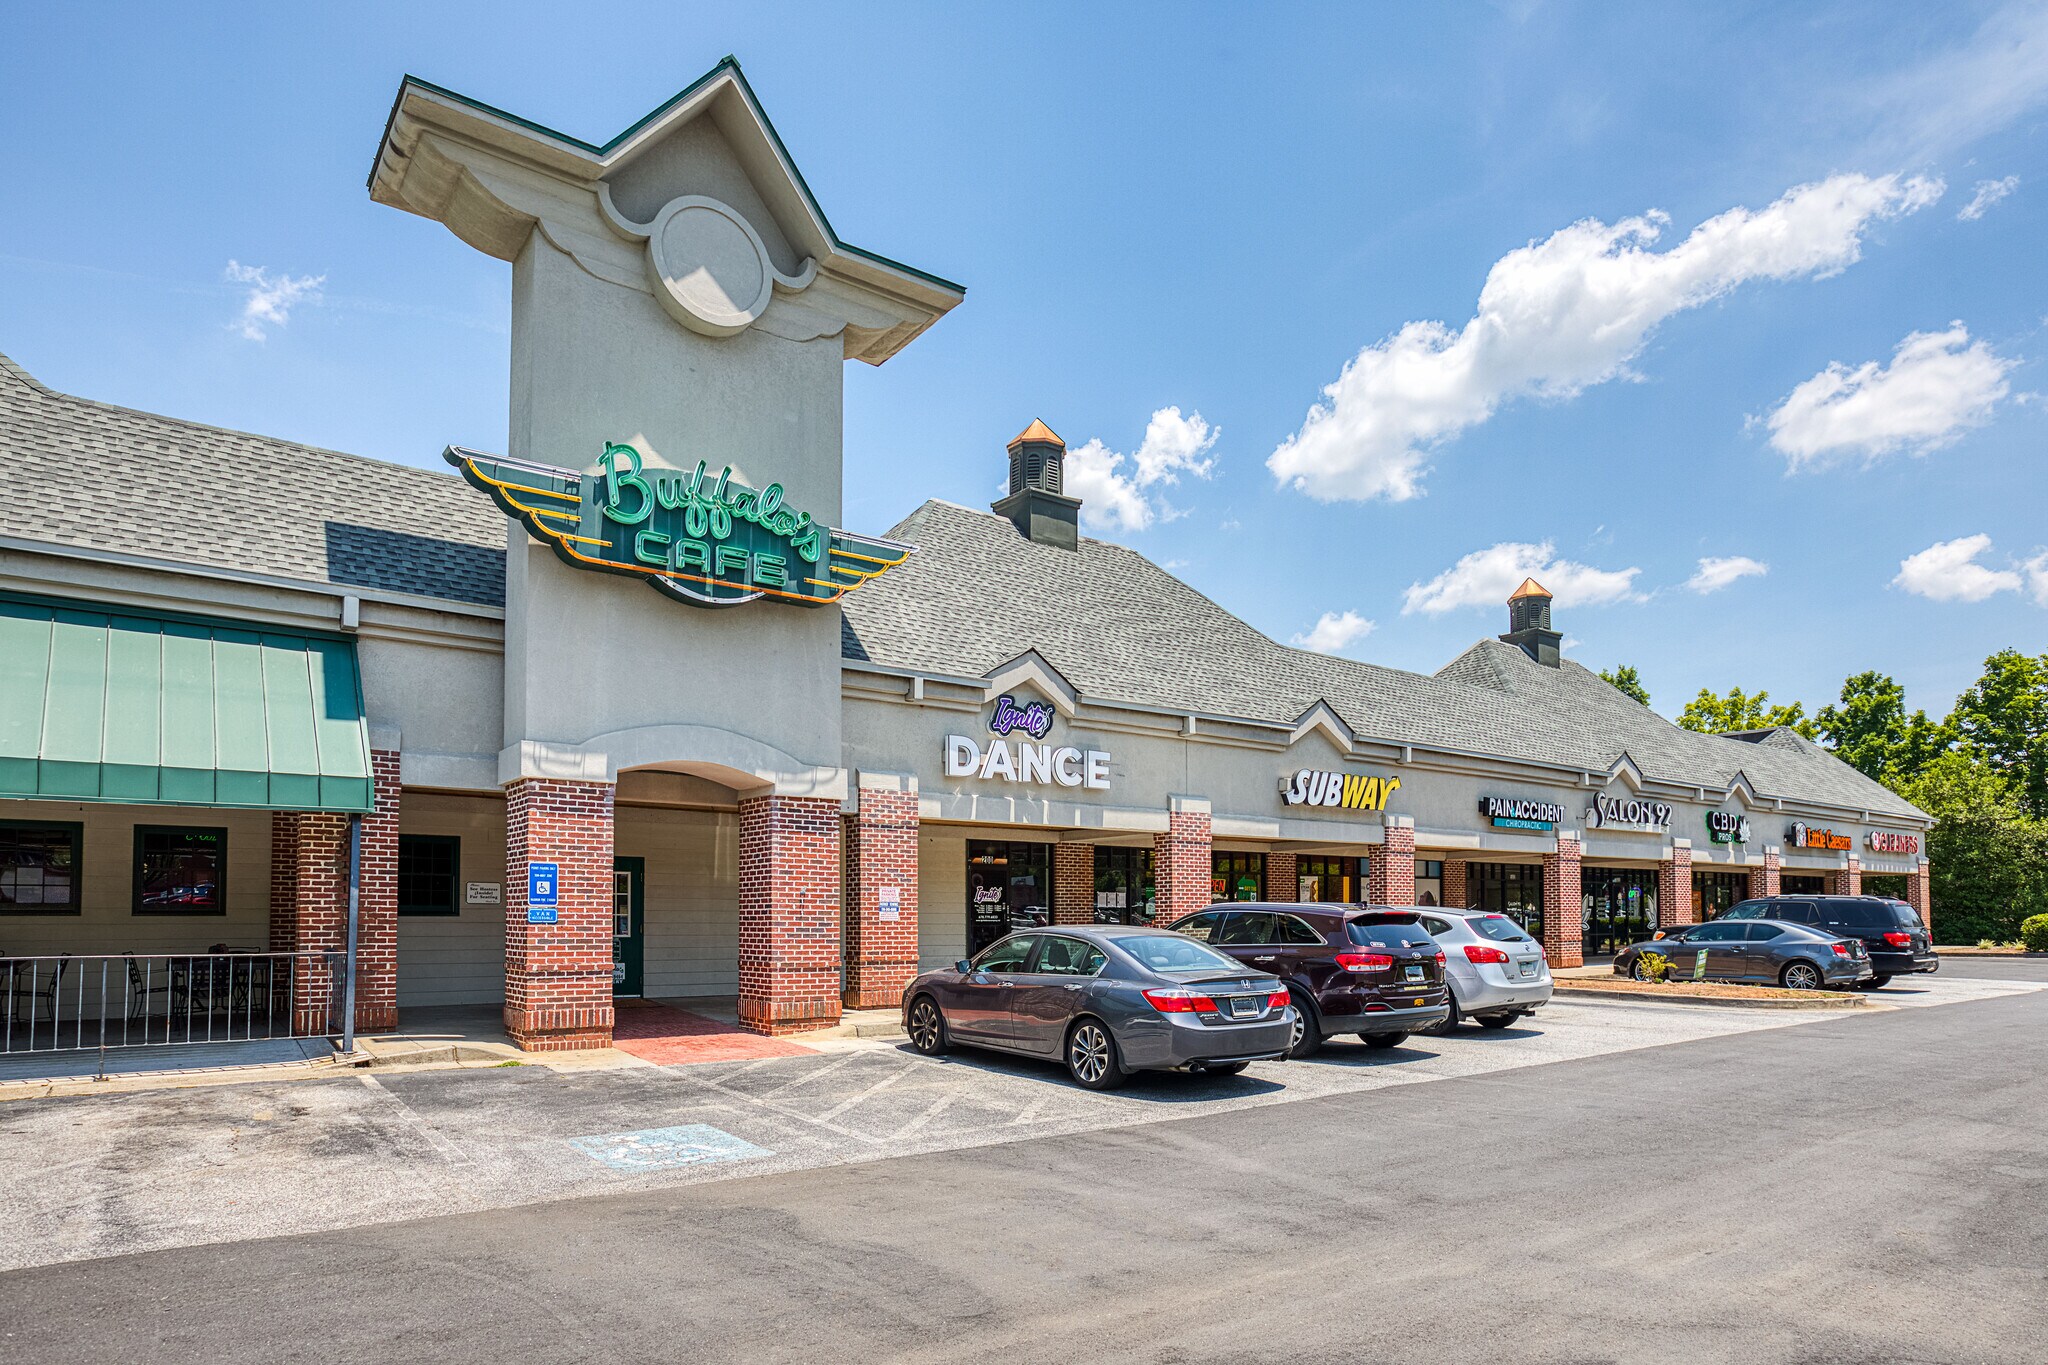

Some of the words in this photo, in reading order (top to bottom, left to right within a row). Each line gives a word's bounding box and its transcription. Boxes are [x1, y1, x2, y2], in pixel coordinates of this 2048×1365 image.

[596, 440, 821, 562] Buffalo's
[635, 530, 786, 586] CAFE
[993, 697, 1046, 734] Ignite
[945, 734, 1112, 789] DANCE
[1282, 768, 1401, 811] SUBWAY
[1488, 797, 1514, 817] PAIN
[1515, 800, 1565, 823] ACCIDENT
[1595, 791, 1652, 827] SALON
[1656, 803, 1672, 826] 92
[1712, 812, 1737, 831] CBD
[1505, 819, 1542, 830] CHIROPRACTIC
[1718, 832, 1732, 841] PROS
[1806, 828, 1826, 848] Little
[1826, 829, 1852, 851] Caesars
[1879, 832, 1919, 855] CLEANERS
[1211, 879, 1225, 892] PEN
